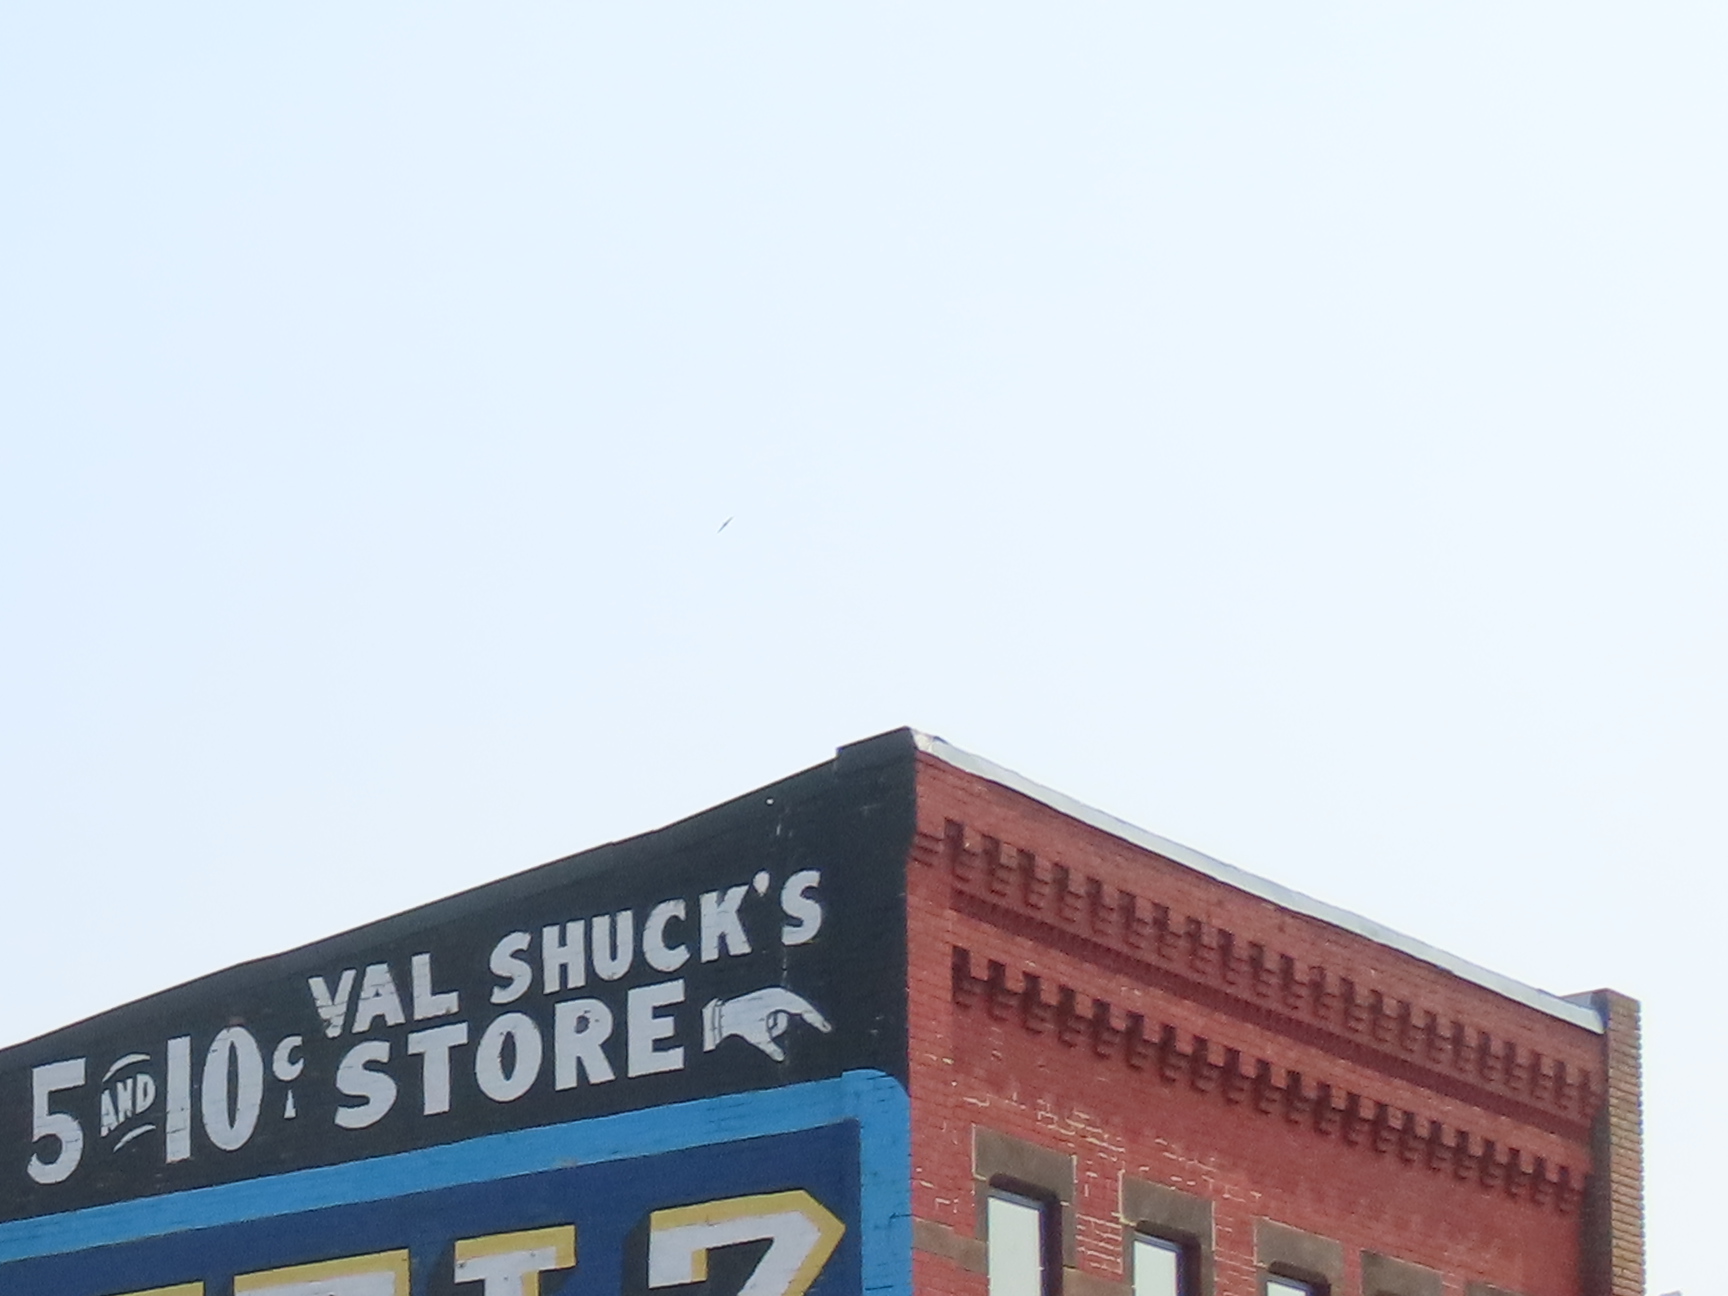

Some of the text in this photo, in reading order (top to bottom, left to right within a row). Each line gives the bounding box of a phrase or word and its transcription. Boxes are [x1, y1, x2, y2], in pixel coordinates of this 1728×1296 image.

[308, 868, 825, 1038] VAL SHUCK'S
[27, 1057, 85, 1184] 5
[99, 1073, 156, 1139] AND
[333, 977, 686, 1130] STORE
